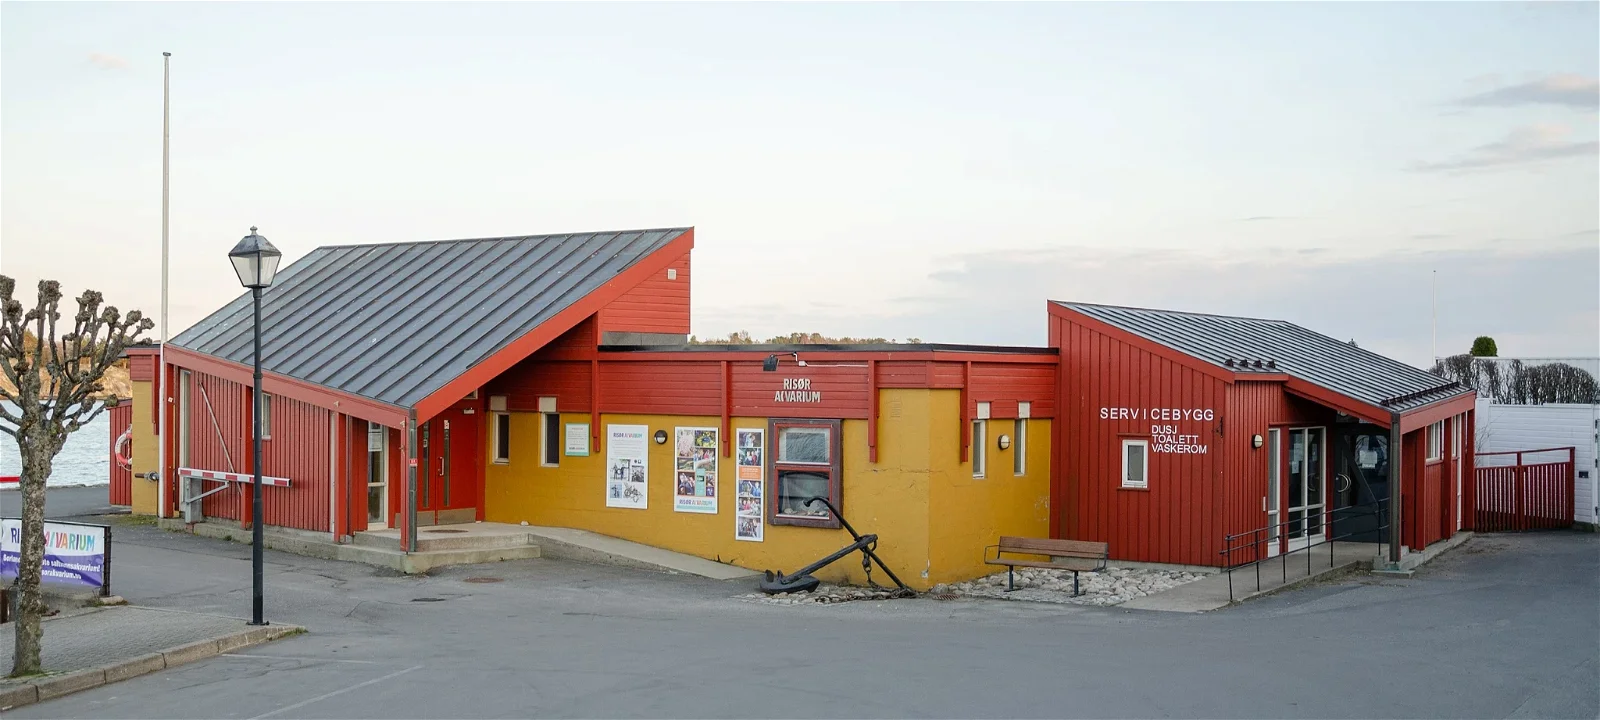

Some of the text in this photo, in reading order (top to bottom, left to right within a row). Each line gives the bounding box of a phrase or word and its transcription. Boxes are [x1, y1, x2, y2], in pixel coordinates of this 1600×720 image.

[783, 378, 811, 390] RISØR
[1151, 425, 1177, 434] DUSJ
[1152, 435, 1199, 444] TOALETT
[1152, 444, 1207, 454] VASKEROM
